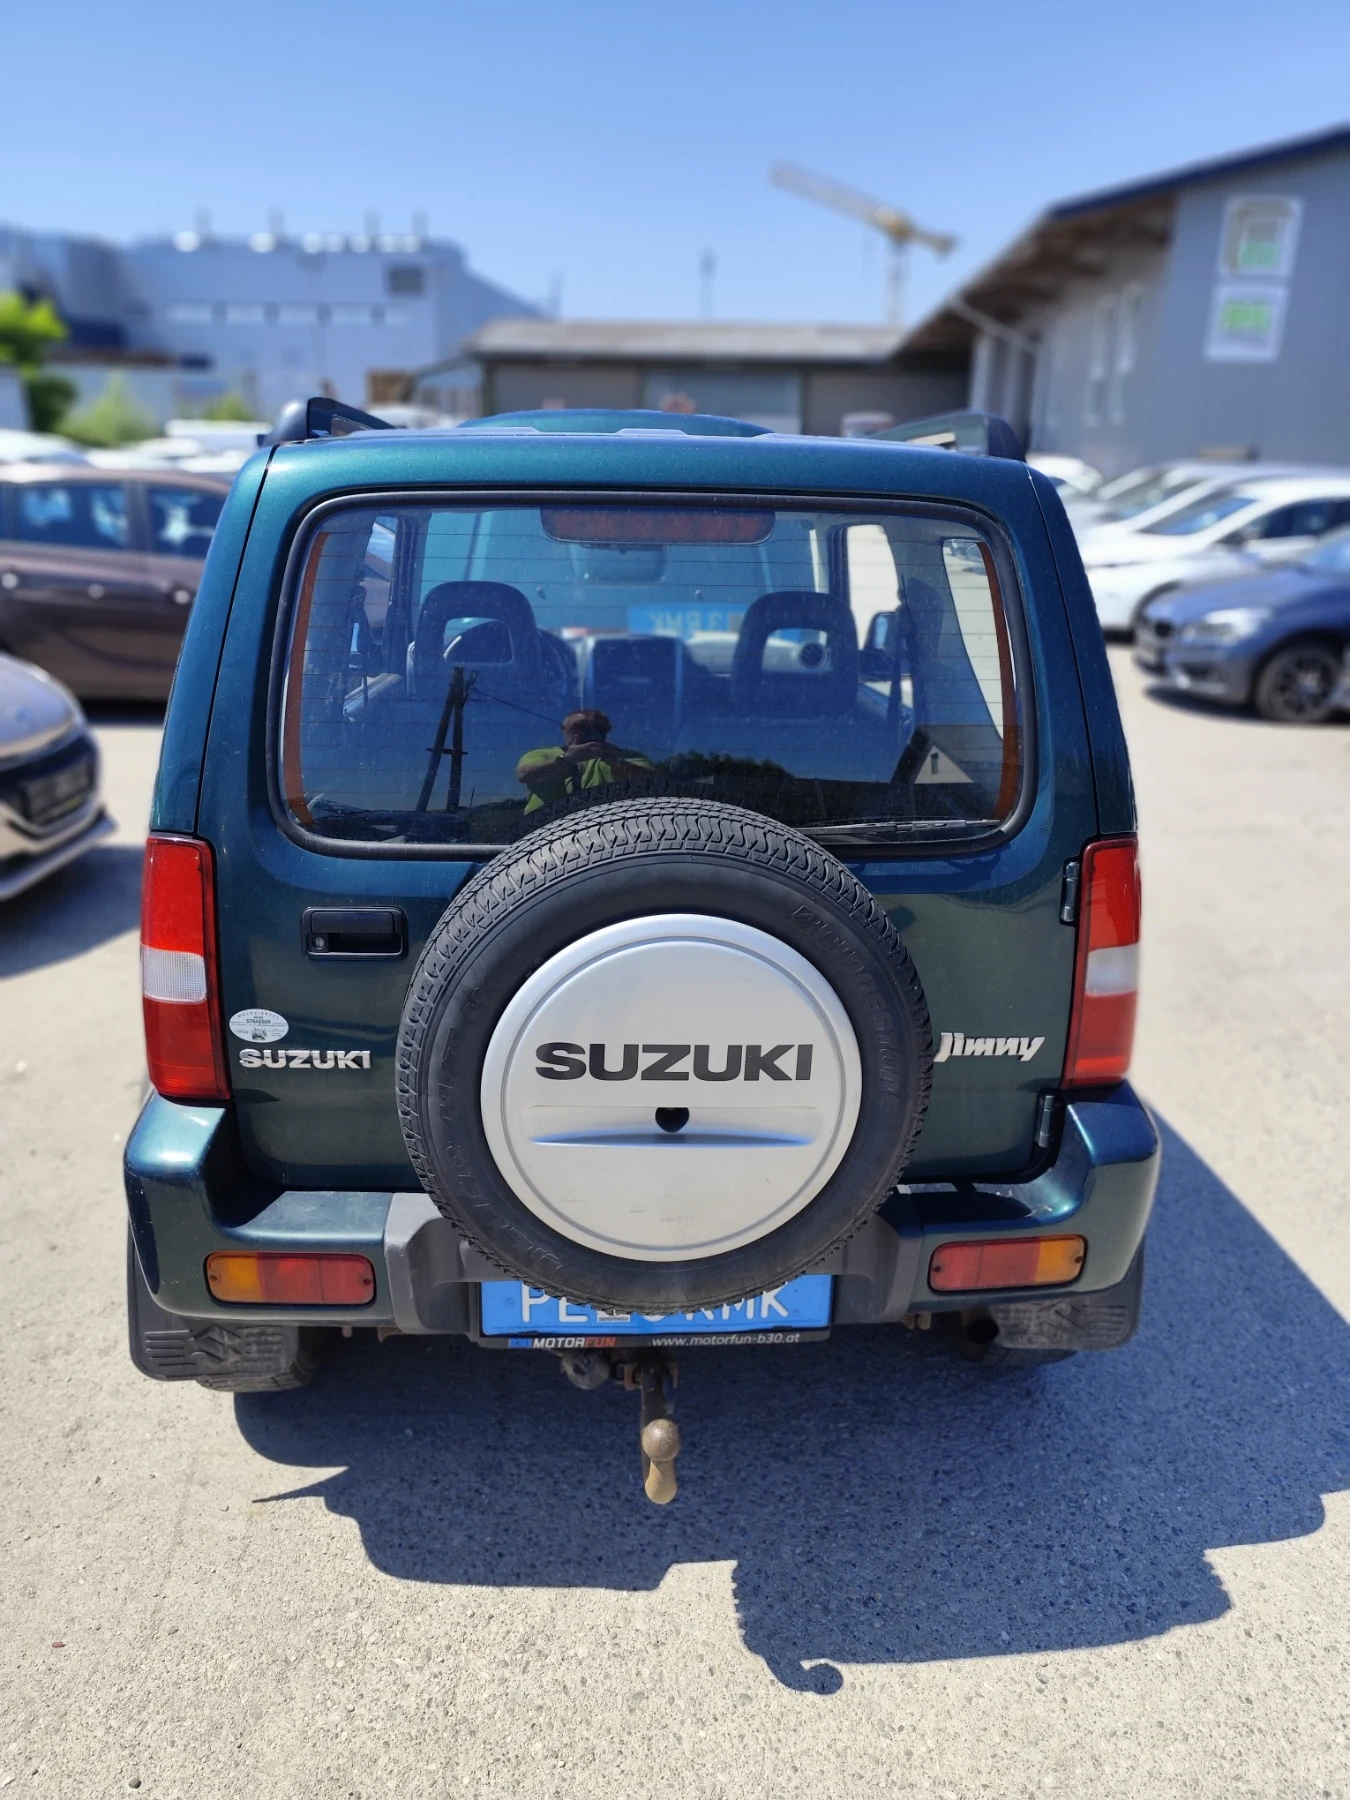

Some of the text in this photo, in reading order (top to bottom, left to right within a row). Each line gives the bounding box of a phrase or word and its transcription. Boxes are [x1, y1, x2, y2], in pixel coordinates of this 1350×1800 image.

[239, 1049, 372, 1069] SUZUKI
[933, 1032, 1046, 1062] Jimny
[534, 1042, 814, 1082] SUZUKI
[532, 1337, 616, 1349] MOTORFUN
[652, 1333, 801, 1346] www.motorfun-b30.at
